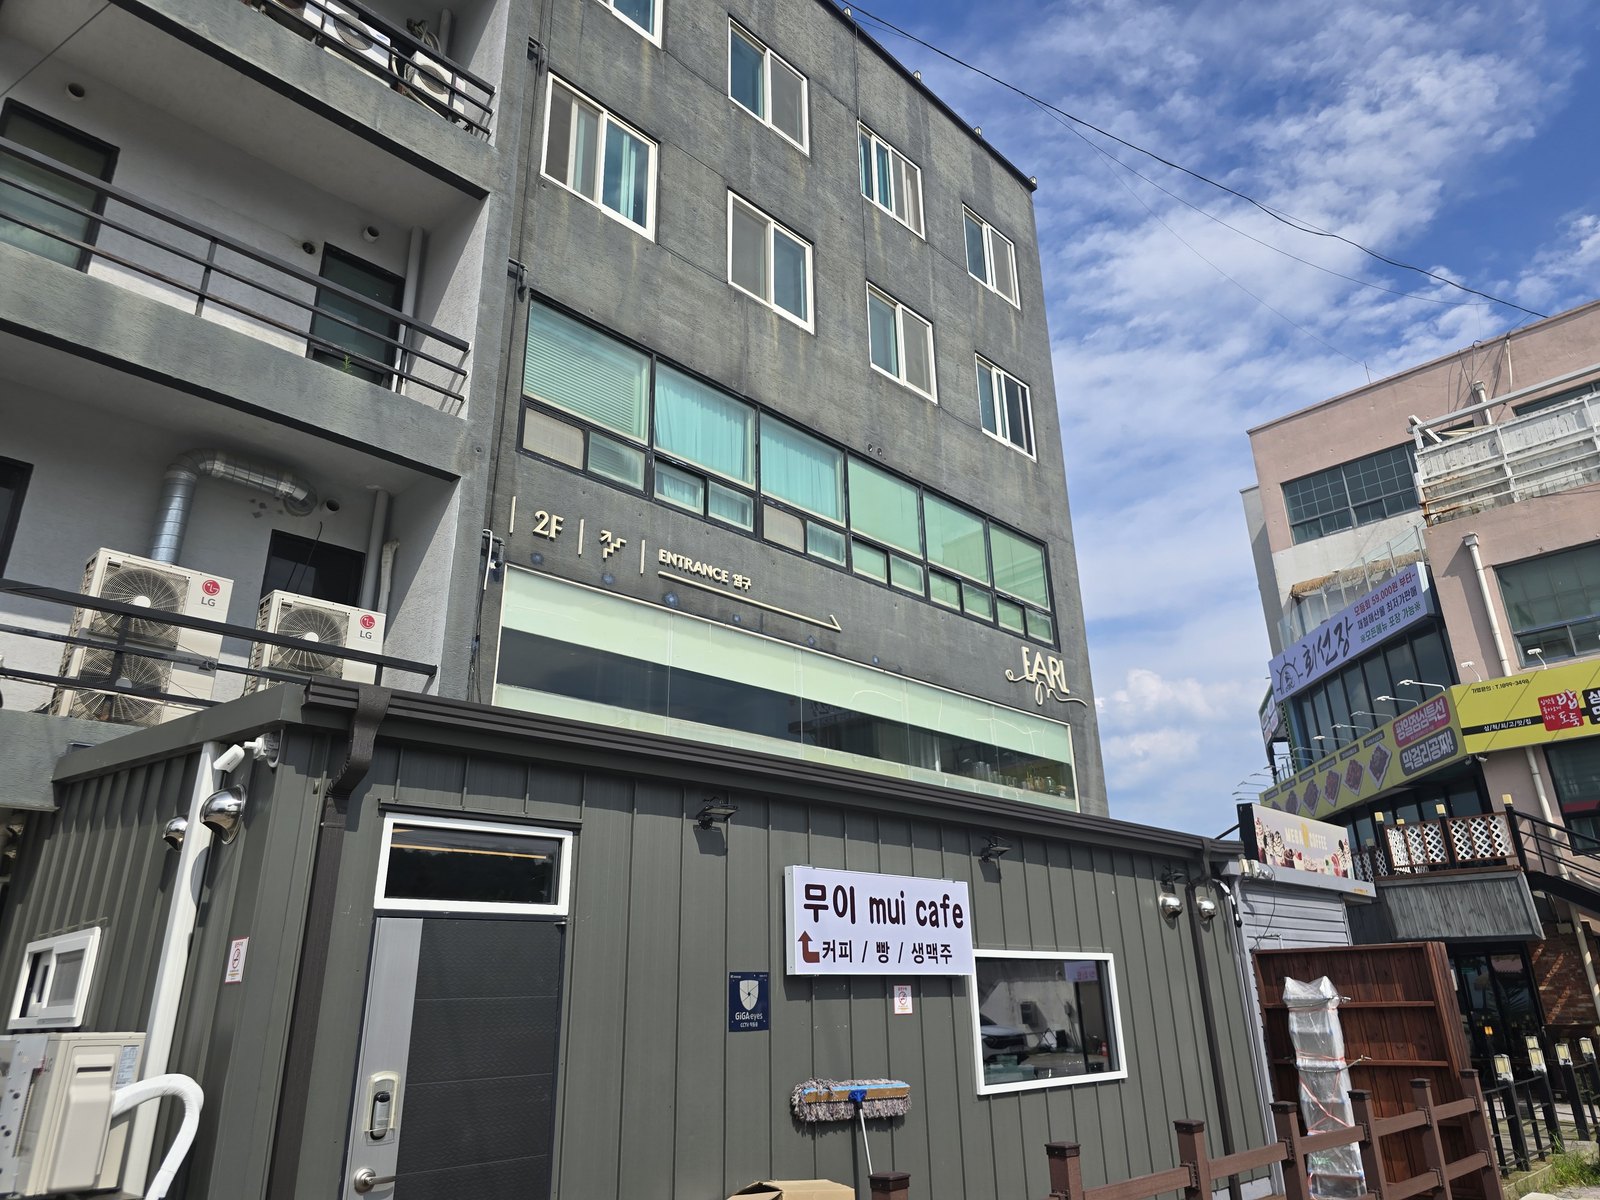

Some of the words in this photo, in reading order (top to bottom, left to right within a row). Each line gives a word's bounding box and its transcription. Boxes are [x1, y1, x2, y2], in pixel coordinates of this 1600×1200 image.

[532, 510, 565, 540] 2F
[658, 548, 729, 584] ENTRANCE
[732, 573, 752, 591] 입구
[201, 596, 216, 607] LG
[1389, 612, 1401, 628] 포장
[359, 630, 372, 640] LG
[1556, 689, 1578, 710] 밥
[1394, 698, 1447, 741] 평일점심특선
[1401, 730, 1454, 770] 막걸리공짜!
[803, 883, 857, 925] 무이
[868, 890, 907, 926] mui
[915, 893, 964, 929] cafe
[822, 939, 853, 964] 커피
[875, 941, 890, 964] 빵
[911, 942, 953, 965] 생맥주
